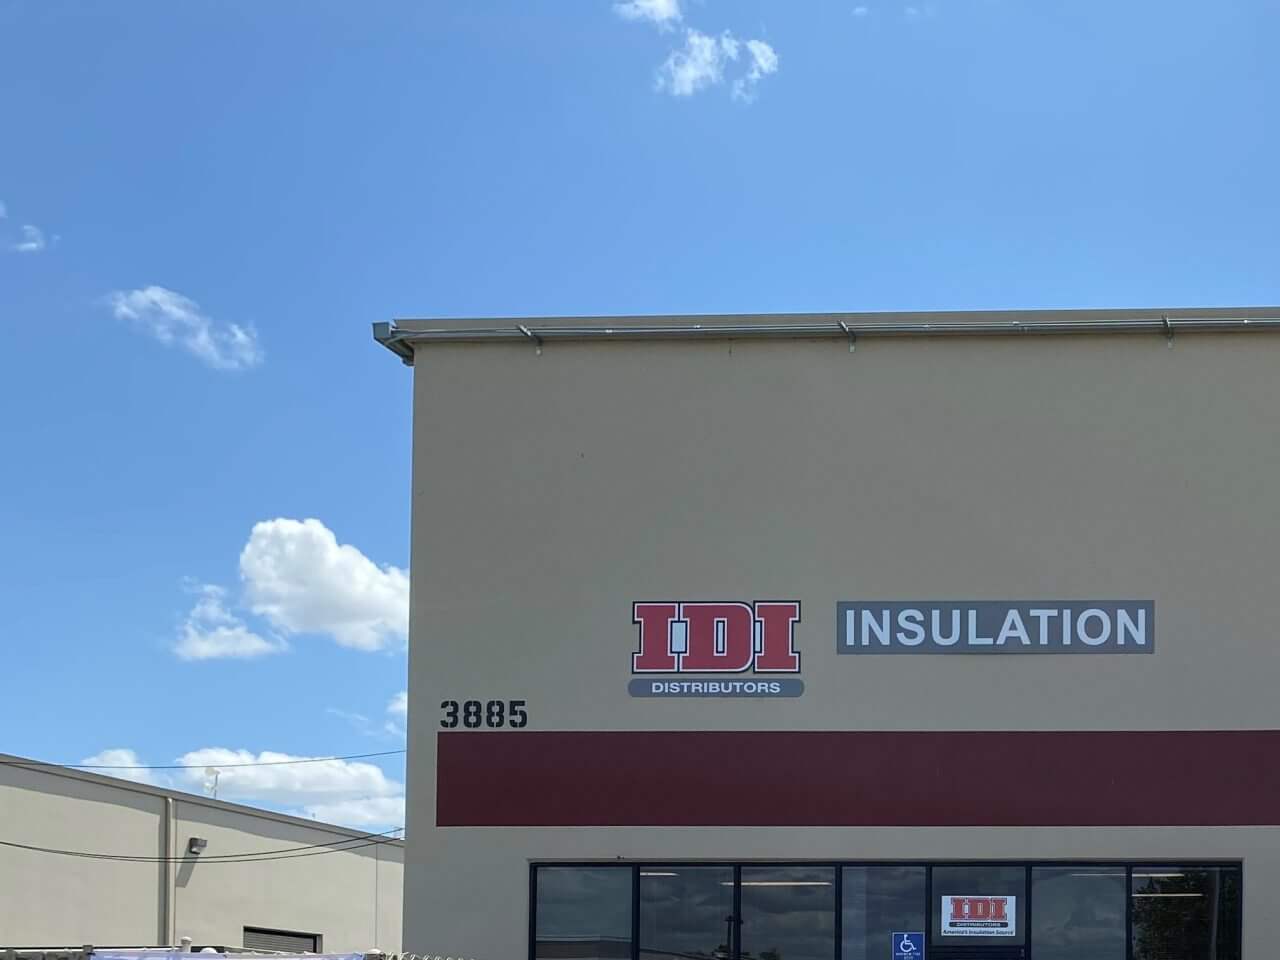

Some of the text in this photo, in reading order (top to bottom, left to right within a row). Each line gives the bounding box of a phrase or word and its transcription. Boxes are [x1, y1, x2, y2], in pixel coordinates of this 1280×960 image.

[632, 601, 801, 674] IDI
[846, 608, 1146, 646] INSULATION
[652, 682, 781, 694] DISTRIBUTORS
[440, 700, 528, 728] 3885
[951, 897, 1007, 921] IDI
